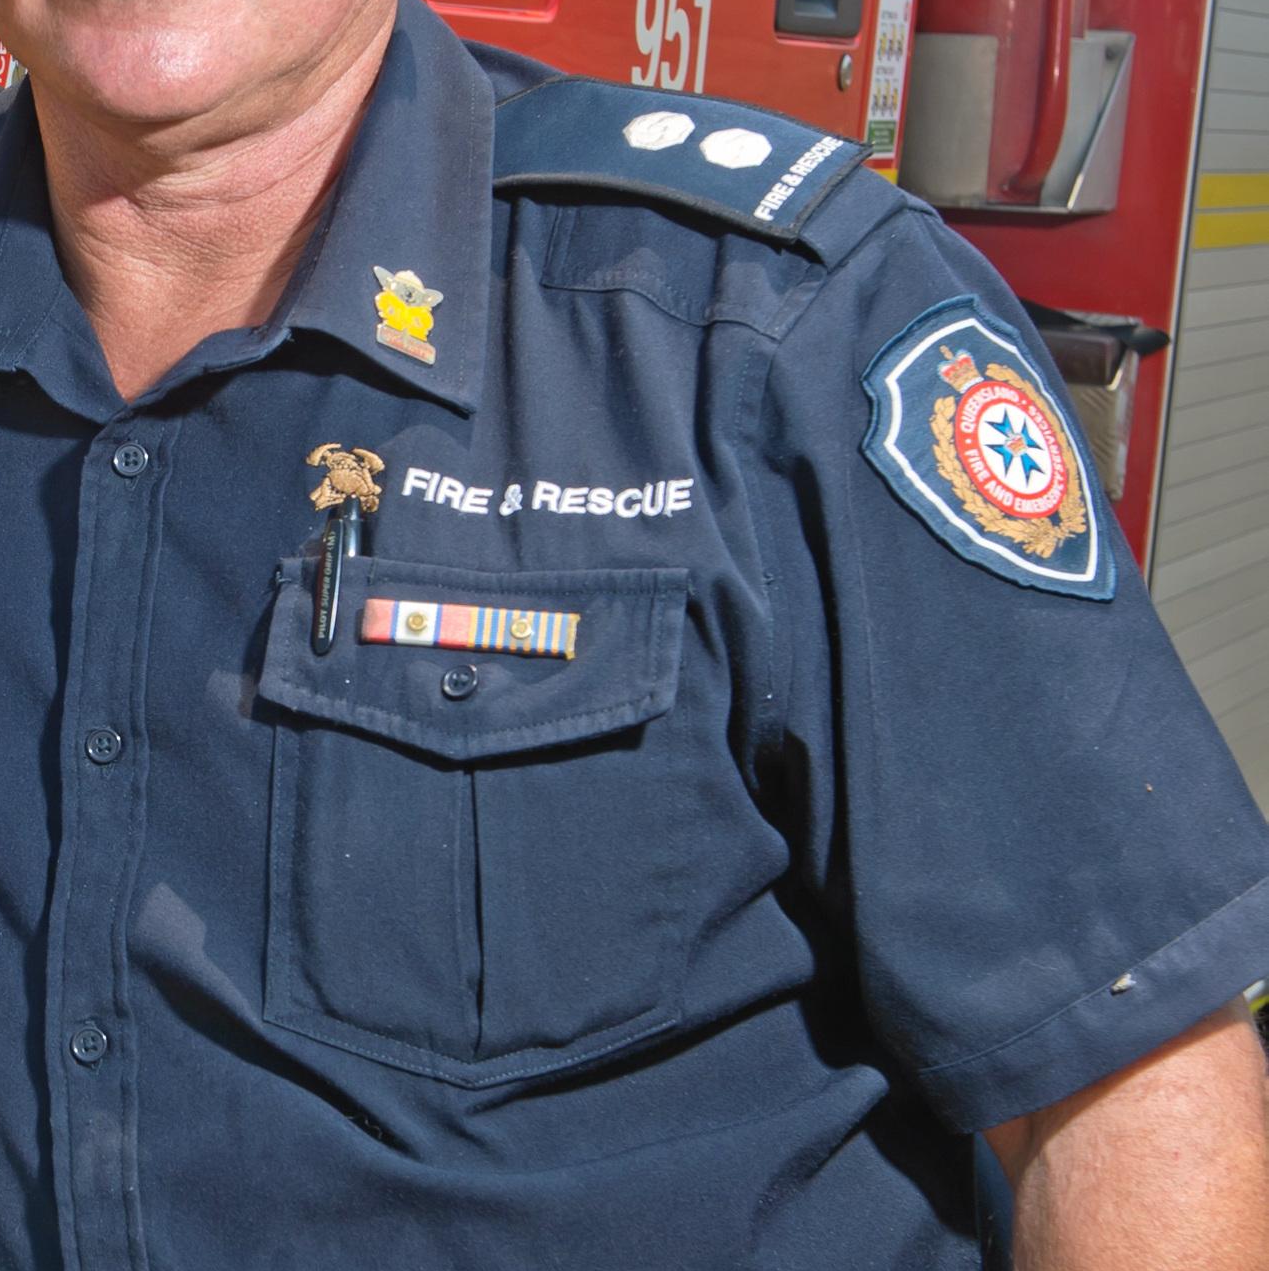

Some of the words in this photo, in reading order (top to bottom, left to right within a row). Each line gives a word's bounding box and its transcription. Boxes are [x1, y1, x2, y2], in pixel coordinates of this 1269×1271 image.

[789, 136, 844, 176] RESCUE
[781, 173, 804, 187] &
[753, 182, 796, 221] FIRE
[960, 385, 1020, 434] QUEENSLAND
[402, 467, 493, 514] FIRE
[499, 483, 523, 516] &
[532, 478, 694, 518] RESCUE
[964, 448, 991, 483] FIRE
[984, 480, 1014, 508] AND
[319, 575, 333, 608] SUPER
[317, 608, 329, 640] PILOT
